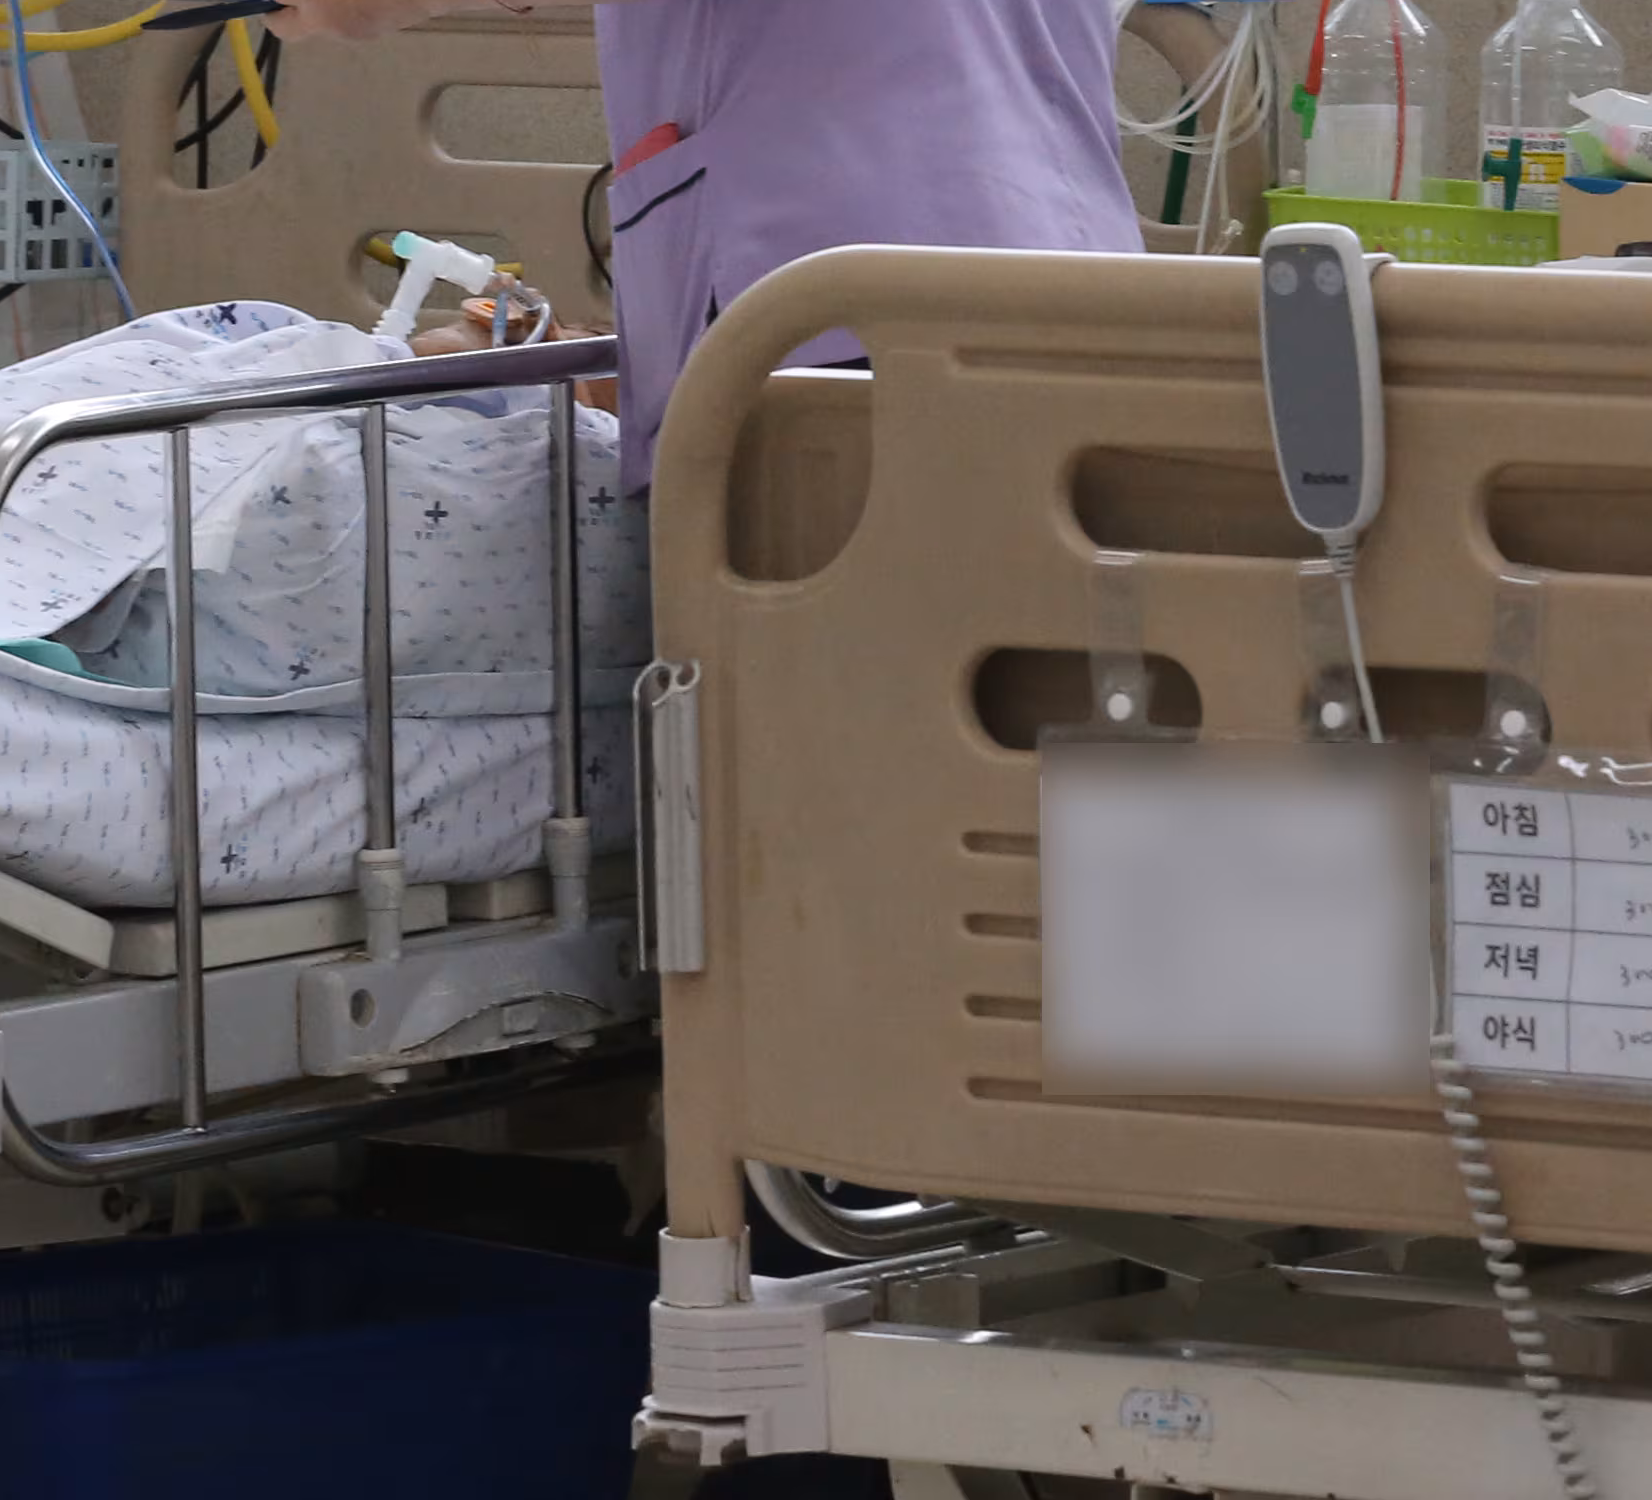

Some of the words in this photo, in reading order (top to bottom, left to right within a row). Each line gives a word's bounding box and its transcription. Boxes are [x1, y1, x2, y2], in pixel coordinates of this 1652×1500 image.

[1482, 801, 1539, 838] 아침
[1484, 870, 1541, 909] 점심
[1483, 942, 1540, 981] 저녁
[1482, 1013, 1536, 1051] 야식
